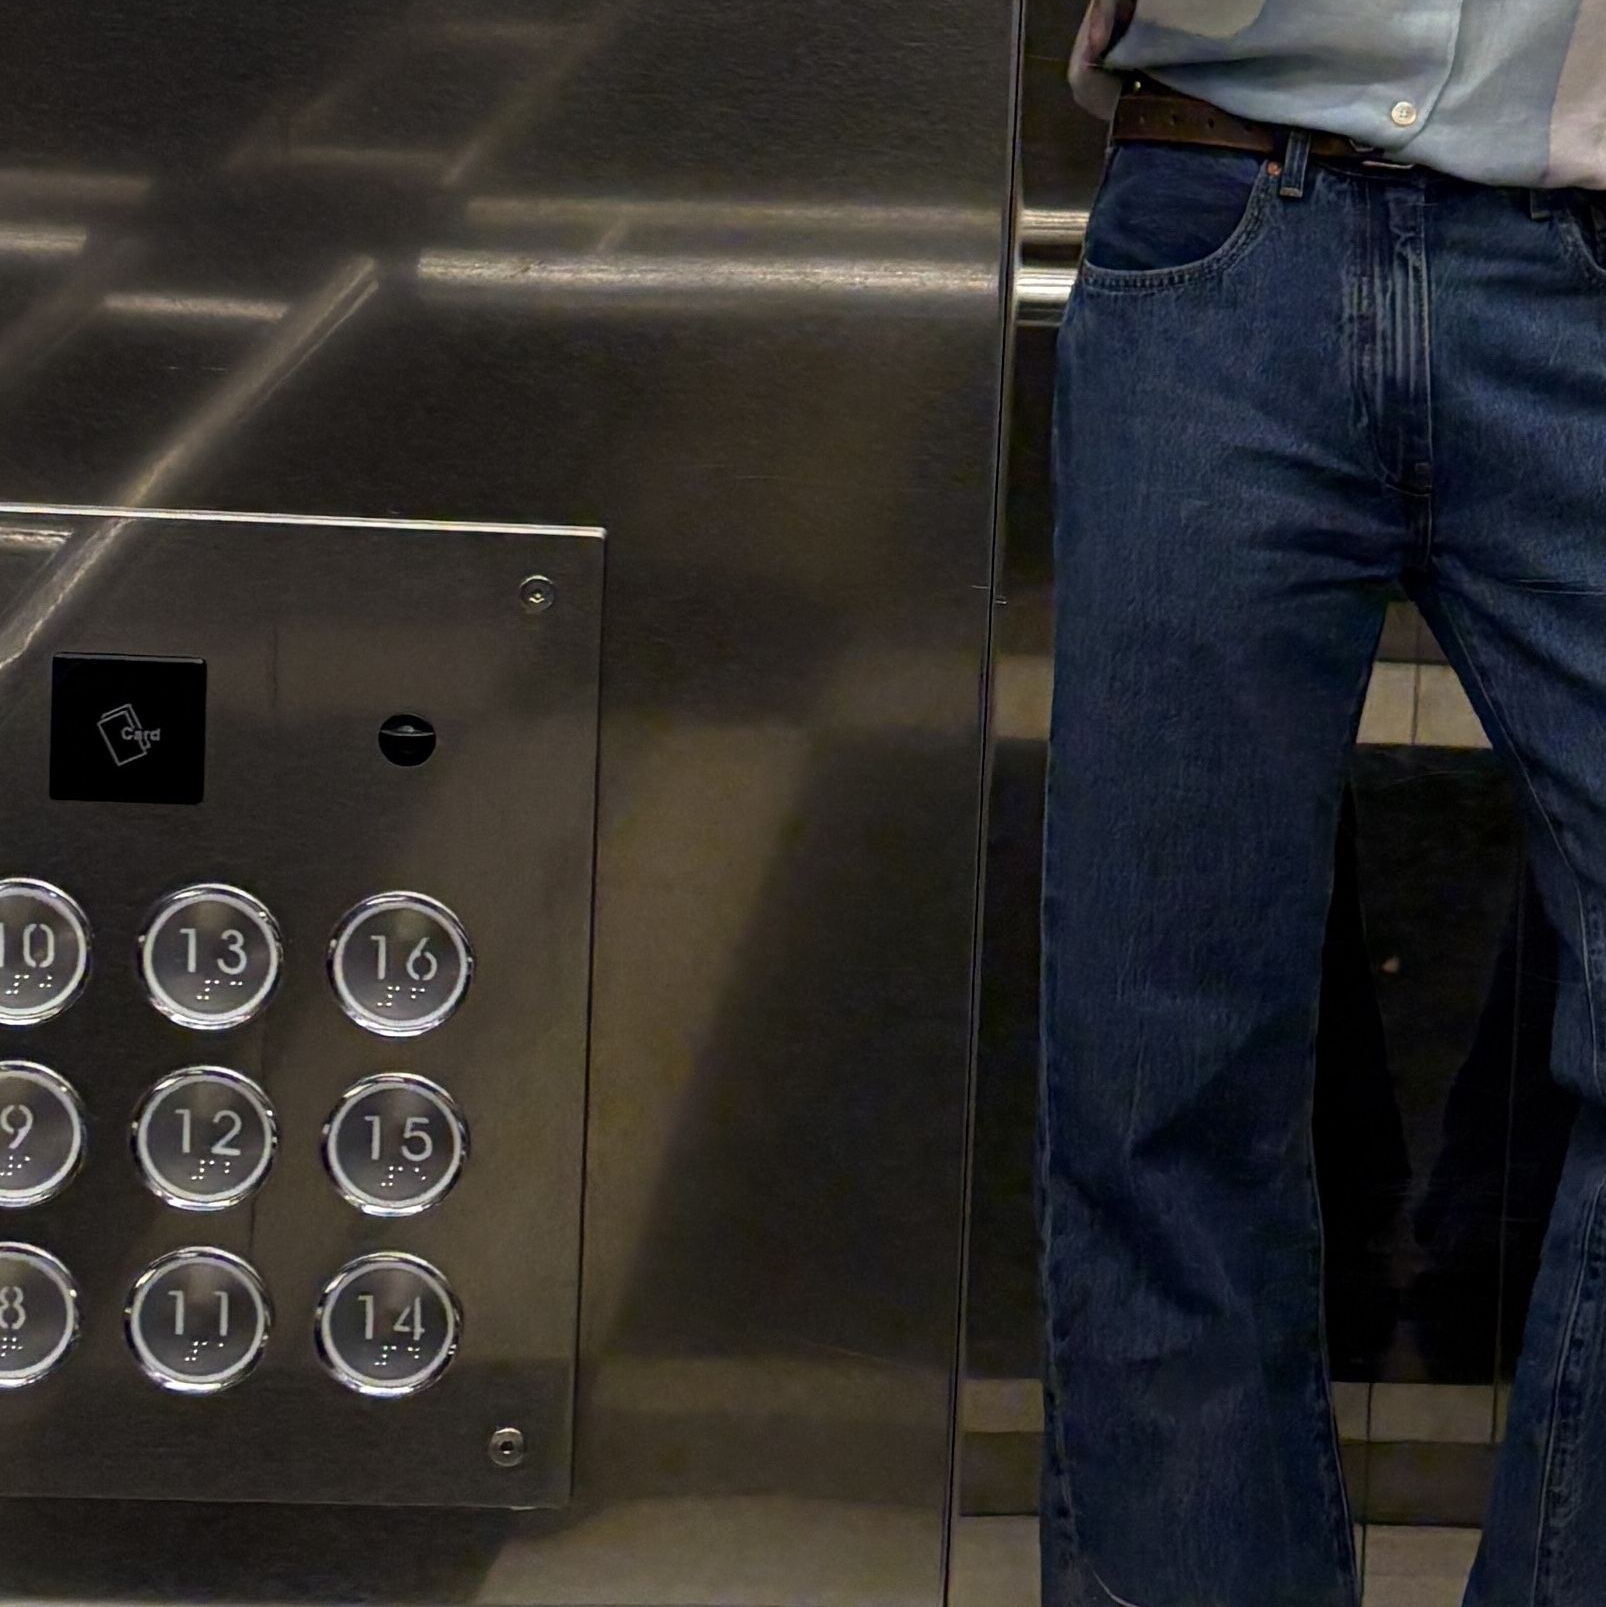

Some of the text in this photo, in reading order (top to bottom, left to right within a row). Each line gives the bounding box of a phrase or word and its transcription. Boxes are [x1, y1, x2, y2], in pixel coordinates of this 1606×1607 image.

[121, 726, 161, 741] Card
[180, 928, 247, 975] 13
[371, 935, 438, 981] 16
[1, 1104, 33, 1150] 9
[175, 1108, 241, 1156] 12
[365, 1115, 433, 1162] 15
[0, 1285, 26, 1330] 8
[169, 1290, 228, 1336] 11
[358, 1295, 425, 1341] 14
